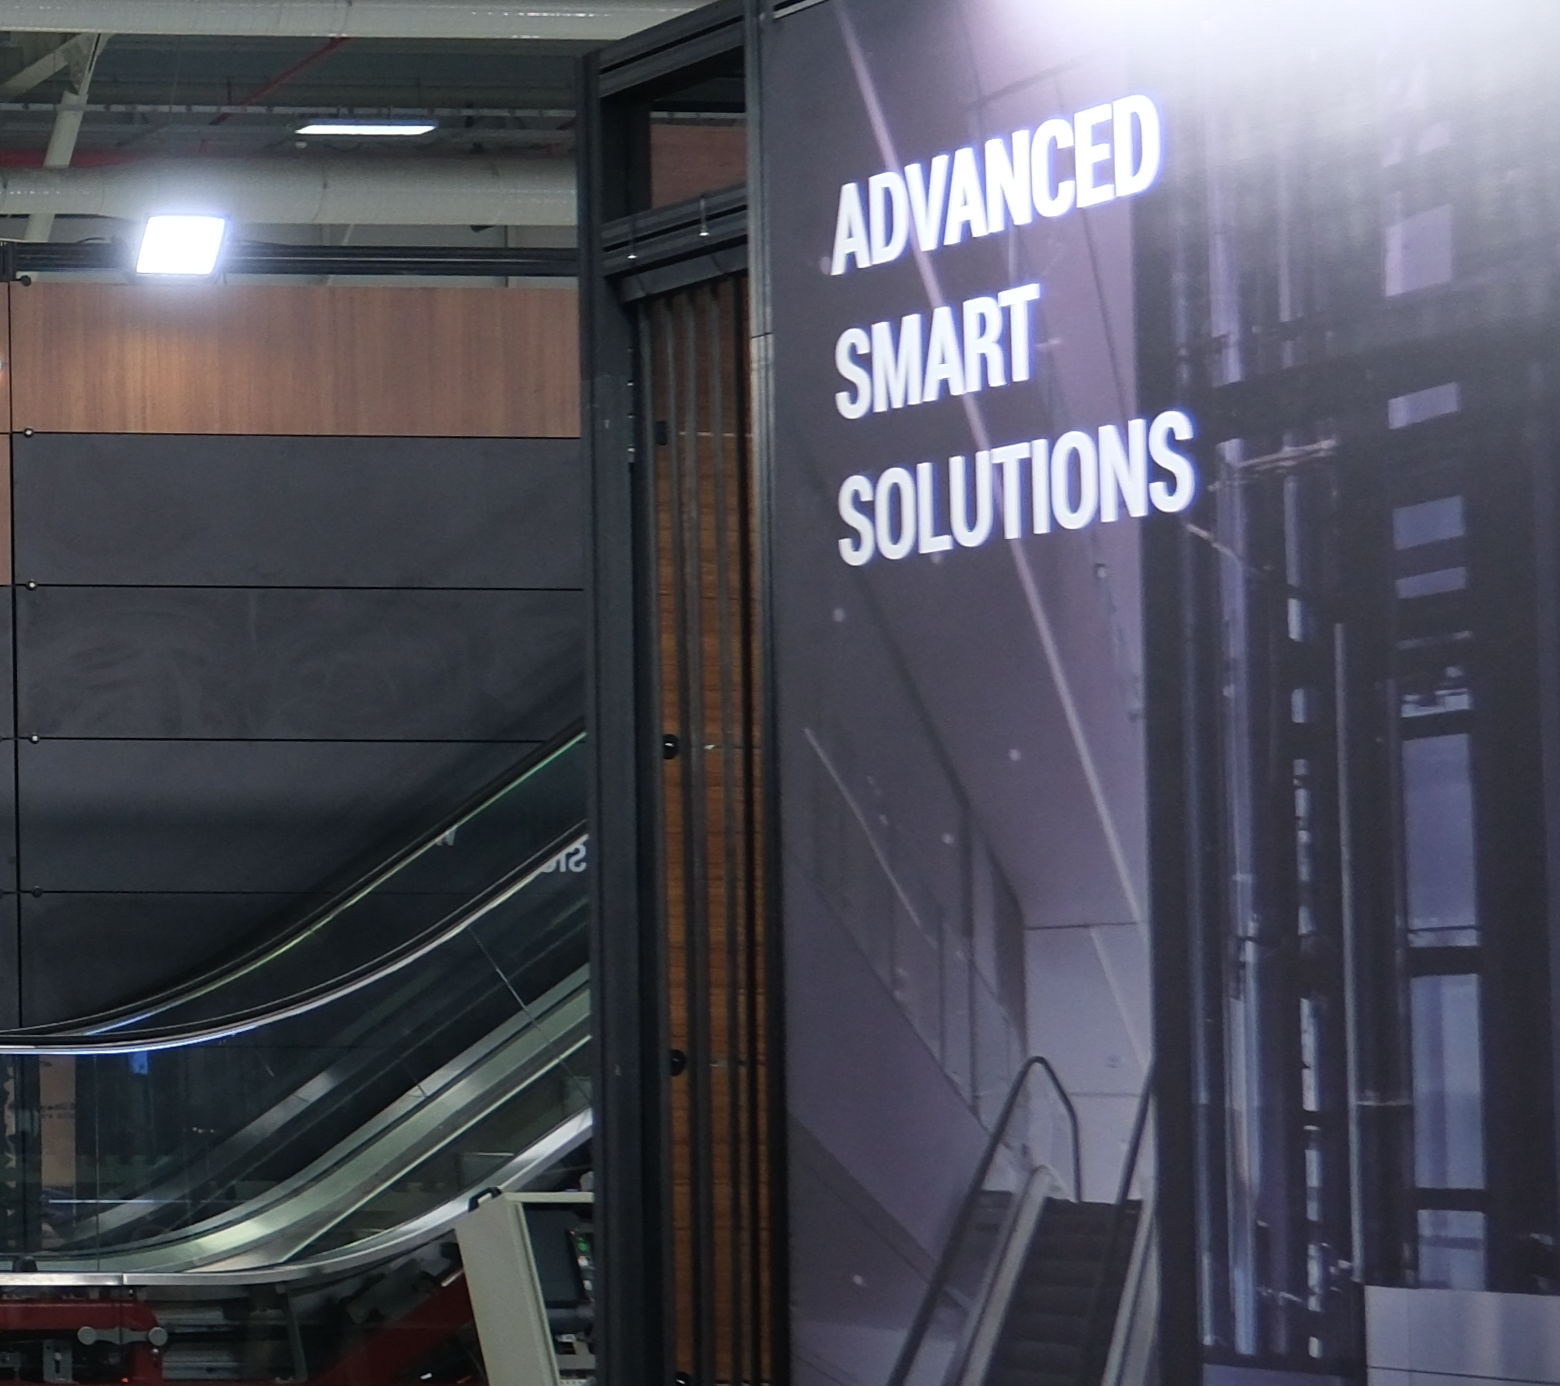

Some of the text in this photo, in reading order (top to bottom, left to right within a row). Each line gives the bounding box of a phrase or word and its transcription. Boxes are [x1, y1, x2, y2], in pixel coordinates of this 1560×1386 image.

[830, 94, 1163, 276] ADVANCED
[834, 282, 1041, 421] SMART
[837, 410, 1196, 566] SOLUTIONS
